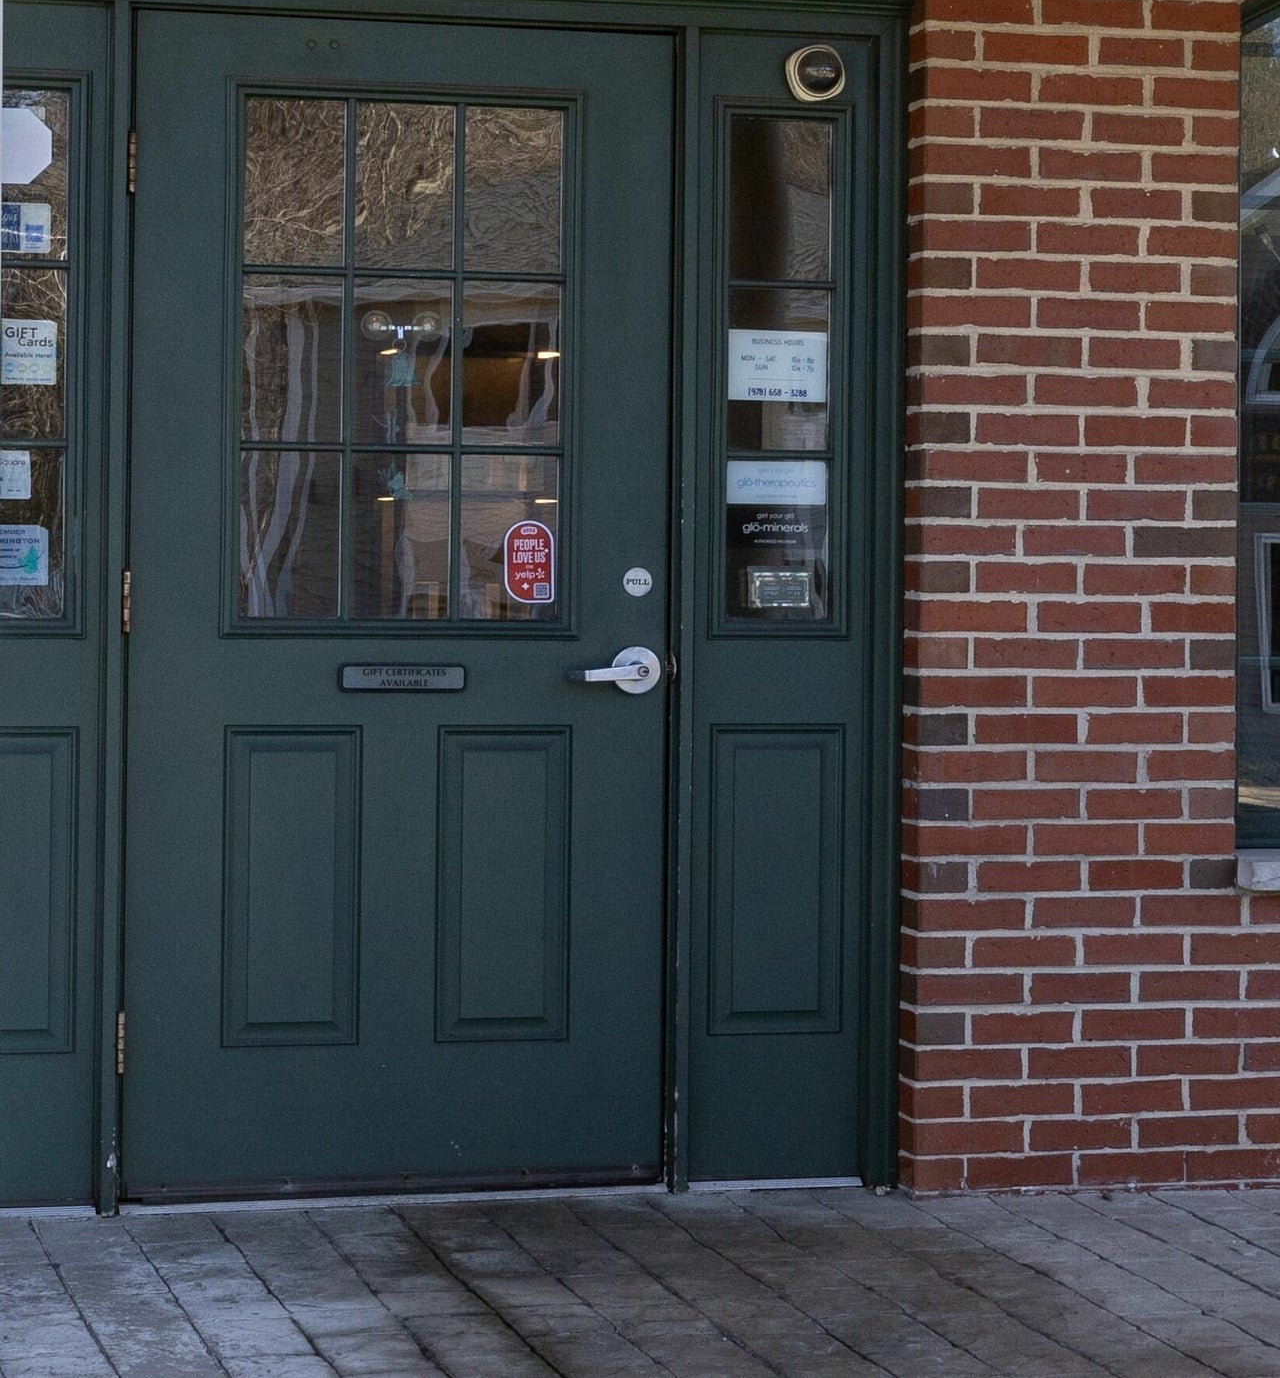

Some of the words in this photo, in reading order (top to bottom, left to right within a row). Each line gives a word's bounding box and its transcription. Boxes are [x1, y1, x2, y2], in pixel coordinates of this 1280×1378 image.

[4, 326, 38, 339] GIFT
[17, 337, 54, 348] Cards
[752, 337, 782, 346] BUSINESS
[783, 338, 805, 347] HOURS
[741, 354, 756, 362] MON
[765, 355, 777, 363] SAT
[768, 387, 783, 397] 658
[513, 538, 545, 551] PEOPLE
[512, 551, 534, 564] LOVE
[534, 551, 546, 564] US
[514, 569, 536, 581] yelp
[626, 578, 650, 586] PULL
[362, 667, 383, 677] GIFT
[385, 667, 447, 678] CERTIFICATES
[379, 678, 429, 688] AVAILABLE
